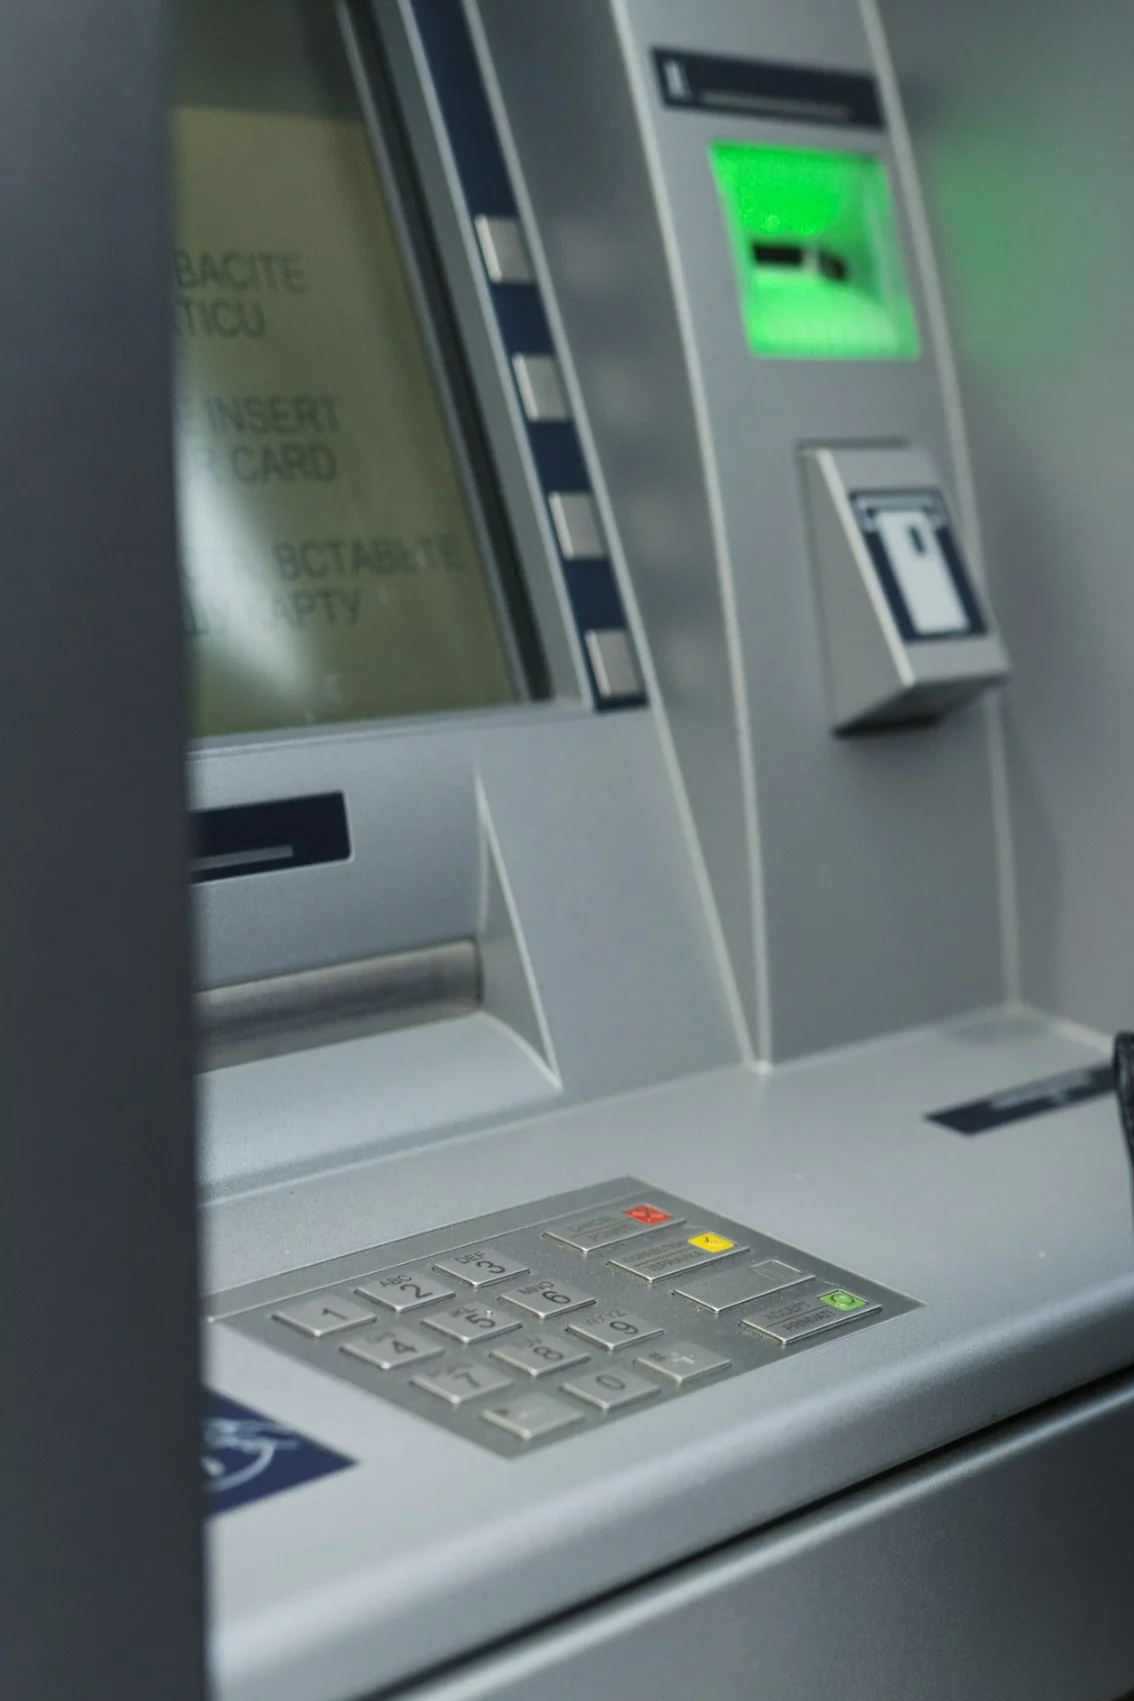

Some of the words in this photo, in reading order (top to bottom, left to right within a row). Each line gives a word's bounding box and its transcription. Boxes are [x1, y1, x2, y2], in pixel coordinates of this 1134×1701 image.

[172, 297, 266, 340] TICU
[205, 394, 341, 434] INSERT
[229, 441, 338, 485] CARD
[454, 1251, 485, 1264] DEF
[476, 1260, 506, 1274] 3
[380, 1274, 413, 1288] ABC
[516, 1280, 555, 1296] MNO
[400, 1283, 434, 1299] 2
[541, 1290, 572, 1305] 6
[323, 1307, 349, 1321] 1
[466, 1312, 497, 1329] 5
[609, 1320, 639, 1335] 9
[392, 1339, 418, 1355] 4
[532, 1345, 565, 1362] 8
[453, 1372, 482, 1389] 7
[595, 1374, 627, 1391] 0
